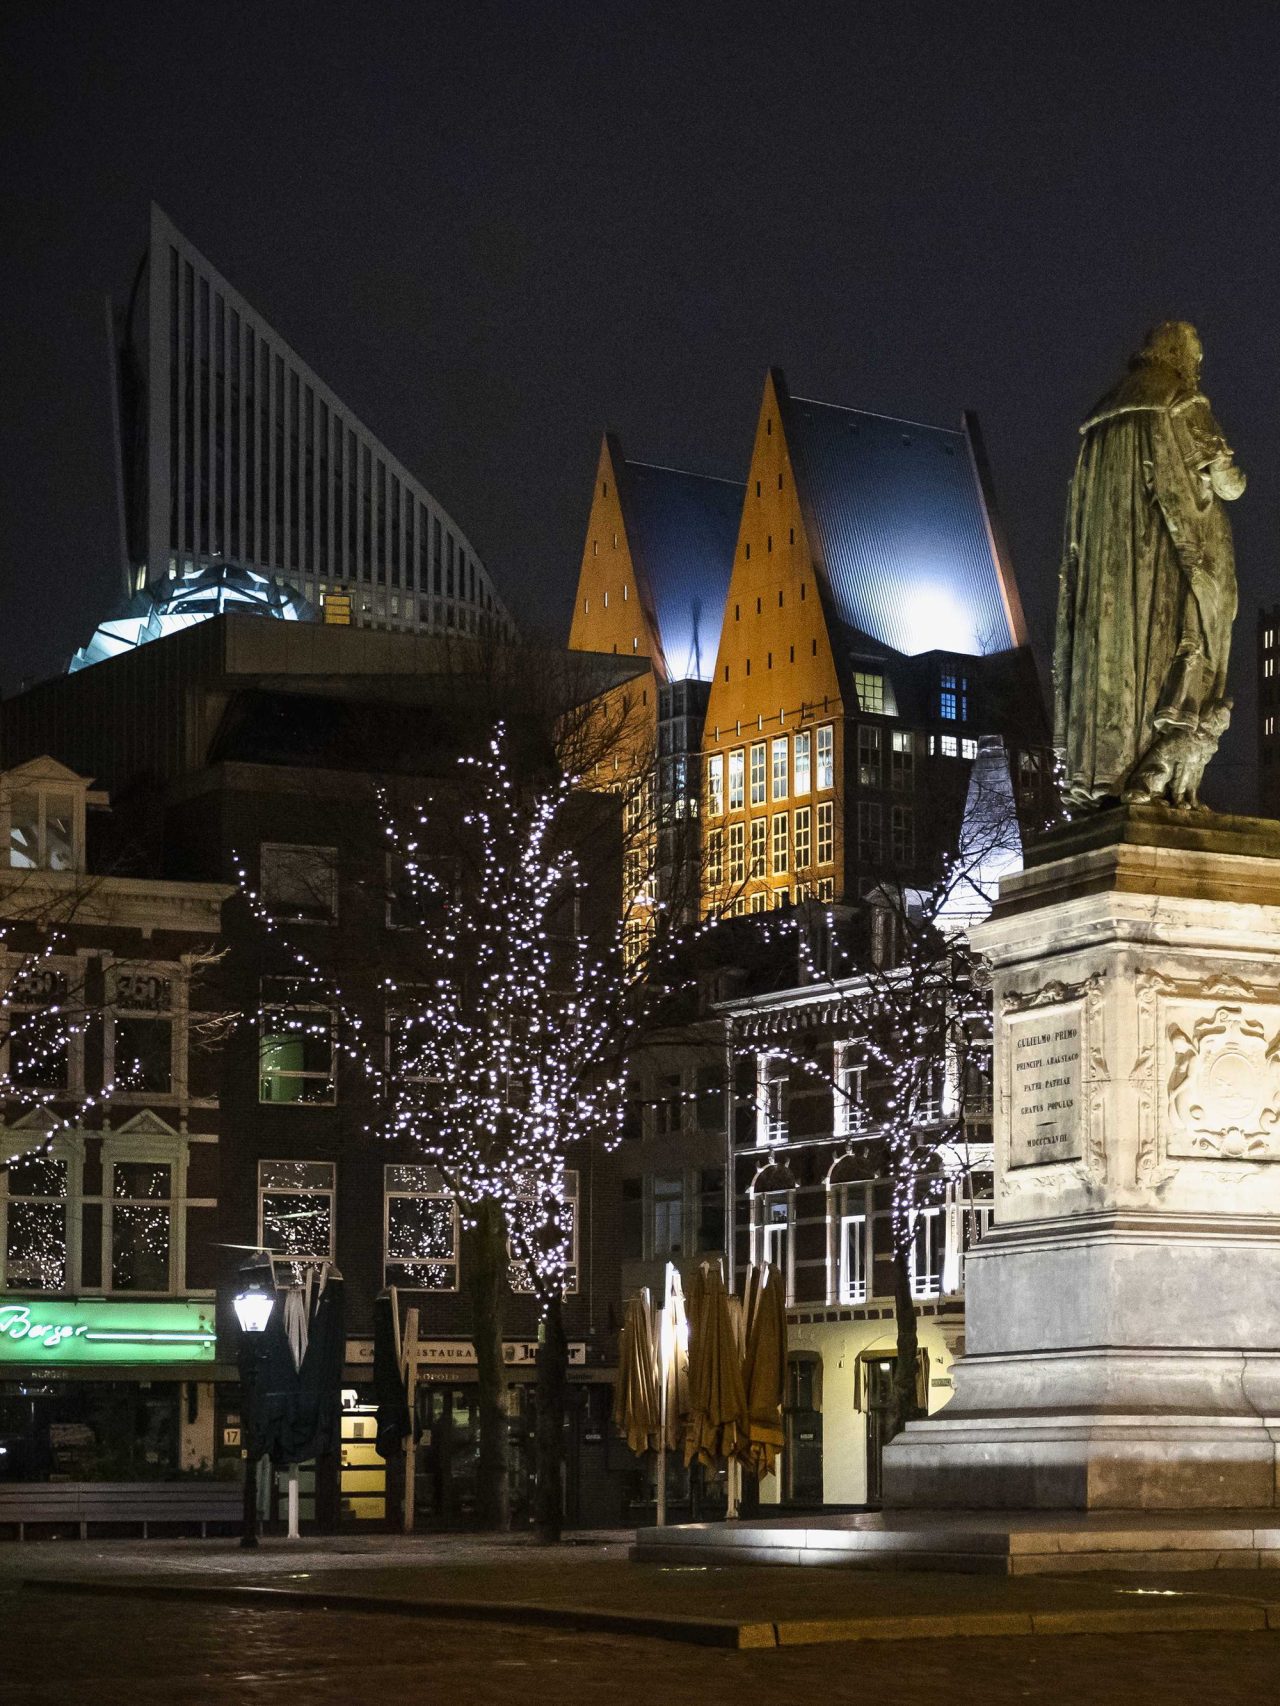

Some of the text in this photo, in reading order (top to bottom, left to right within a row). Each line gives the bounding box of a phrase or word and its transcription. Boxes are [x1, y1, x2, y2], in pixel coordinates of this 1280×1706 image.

[1017, 1028, 1077, 1049] GULIELMO PRIMO
[1021, 1098, 1074, 1115] GRATUS POPULUS
[226, 1431, 239, 1443] 17
